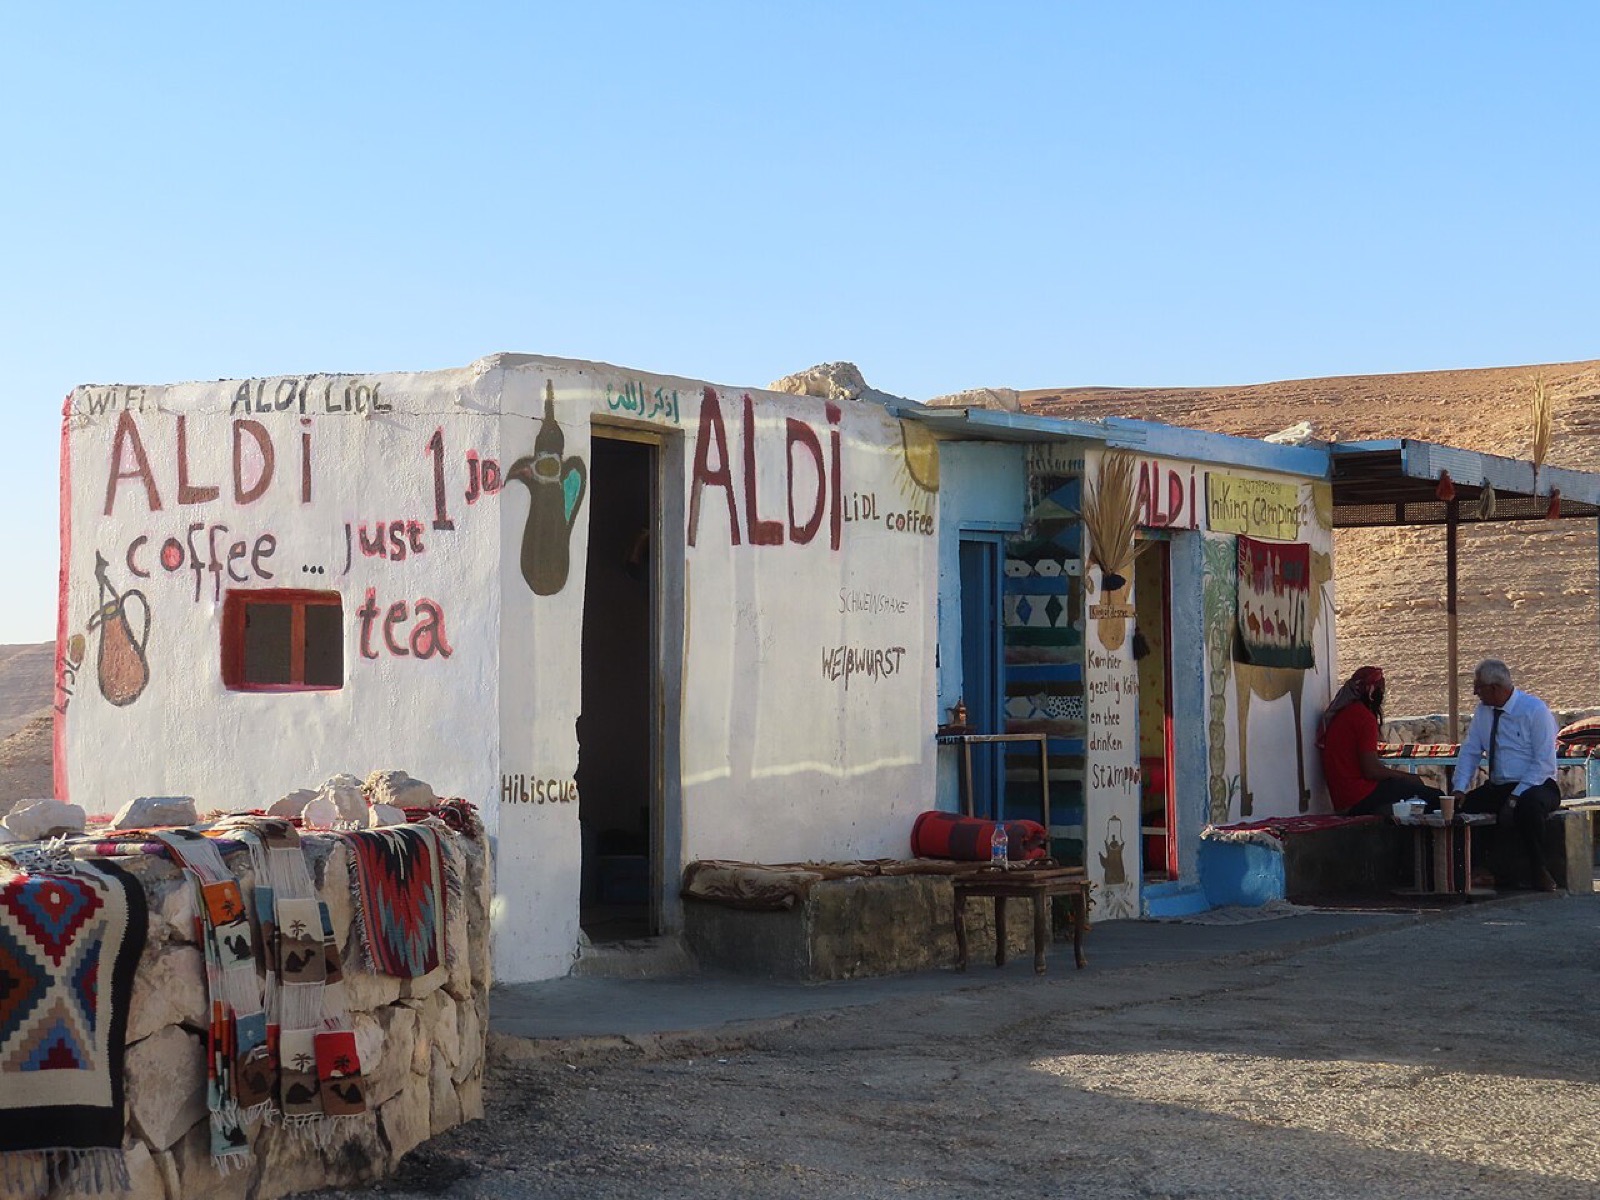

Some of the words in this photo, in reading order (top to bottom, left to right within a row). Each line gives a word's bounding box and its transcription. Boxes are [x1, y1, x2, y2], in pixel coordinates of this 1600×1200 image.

[427, 427, 454, 530] 1
[127, 523, 277, 604] coffee
[357, 588, 453, 660] tea
[1090, 712, 1101, 724] en
